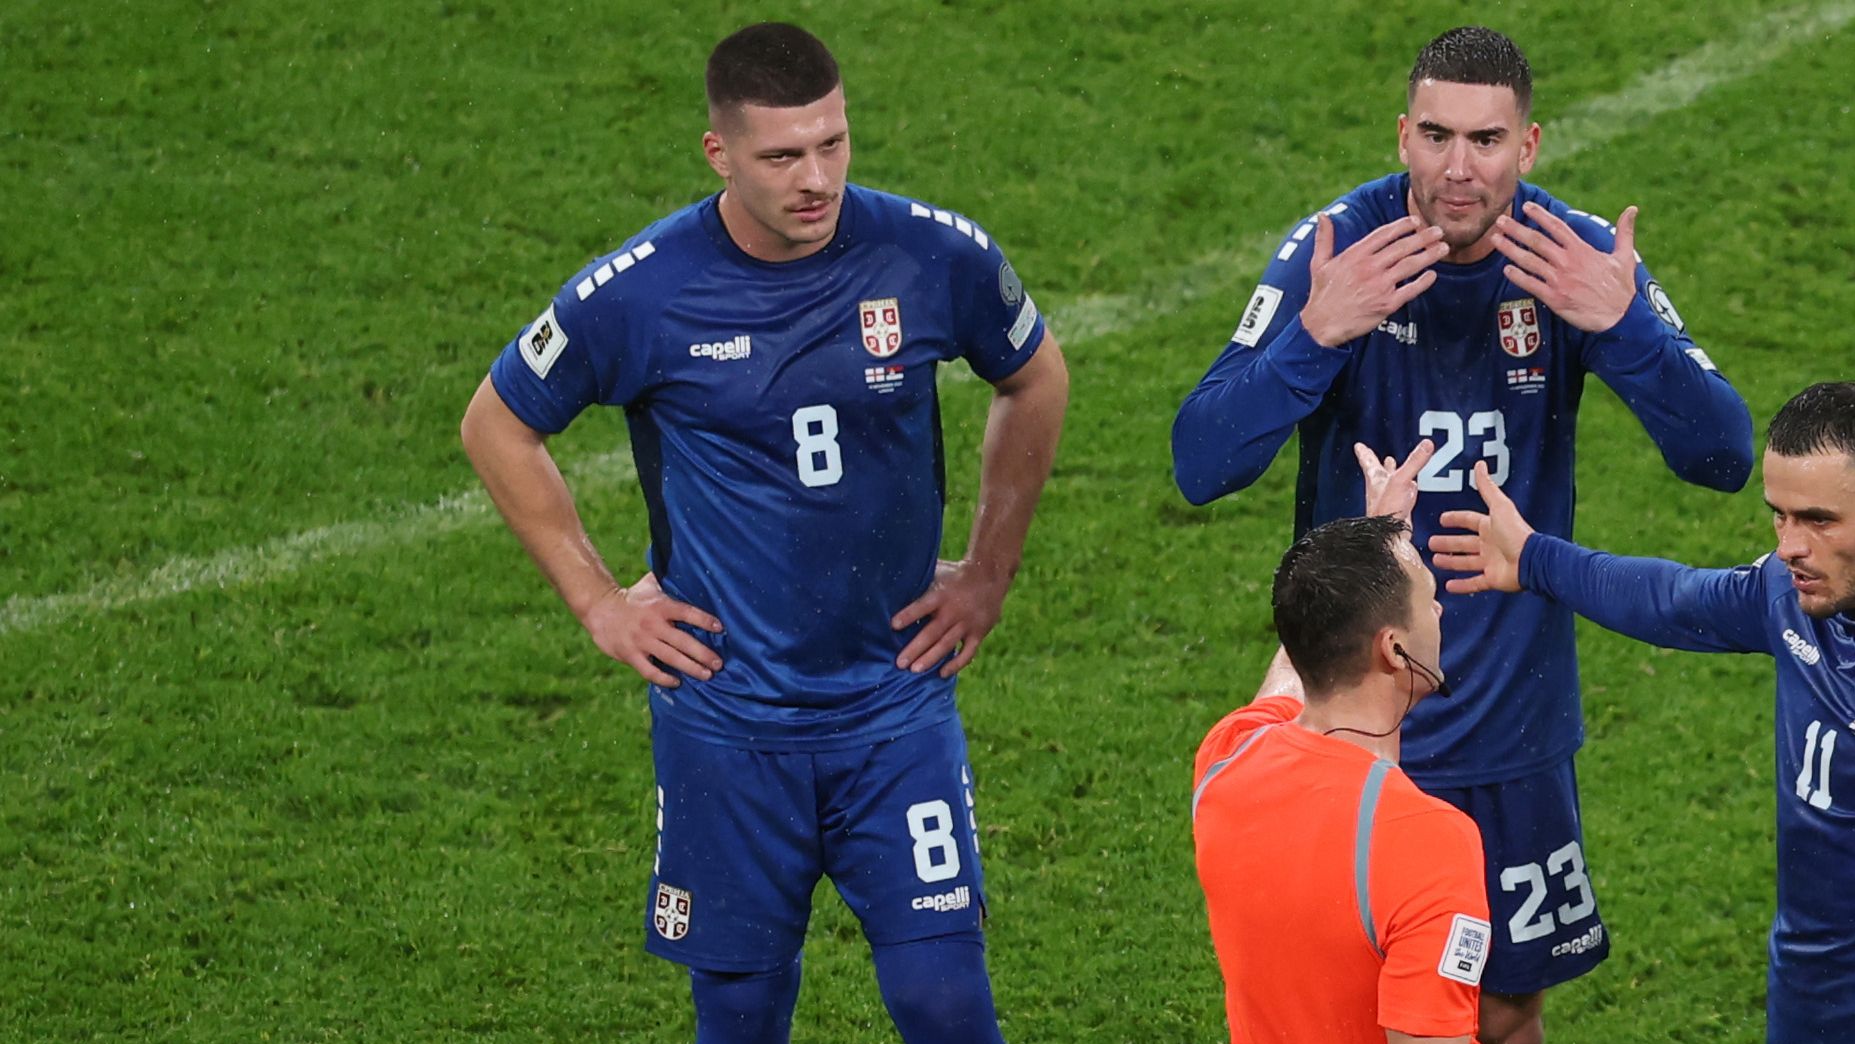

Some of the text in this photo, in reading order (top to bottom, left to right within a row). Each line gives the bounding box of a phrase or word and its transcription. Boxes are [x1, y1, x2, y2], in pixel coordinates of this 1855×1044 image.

[689, 335, 751, 360] capelli
[792, 404, 843, 487] 8
[1417, 409, 1510, 492] 23
[1796, 719, 1838, 810] 11
[906, 799, 961, 883] 8
[911, 886, 970, 912] capelli
[1500, 840, 1596, 944] 23
[1551, 924, 1603, 957] capelli
